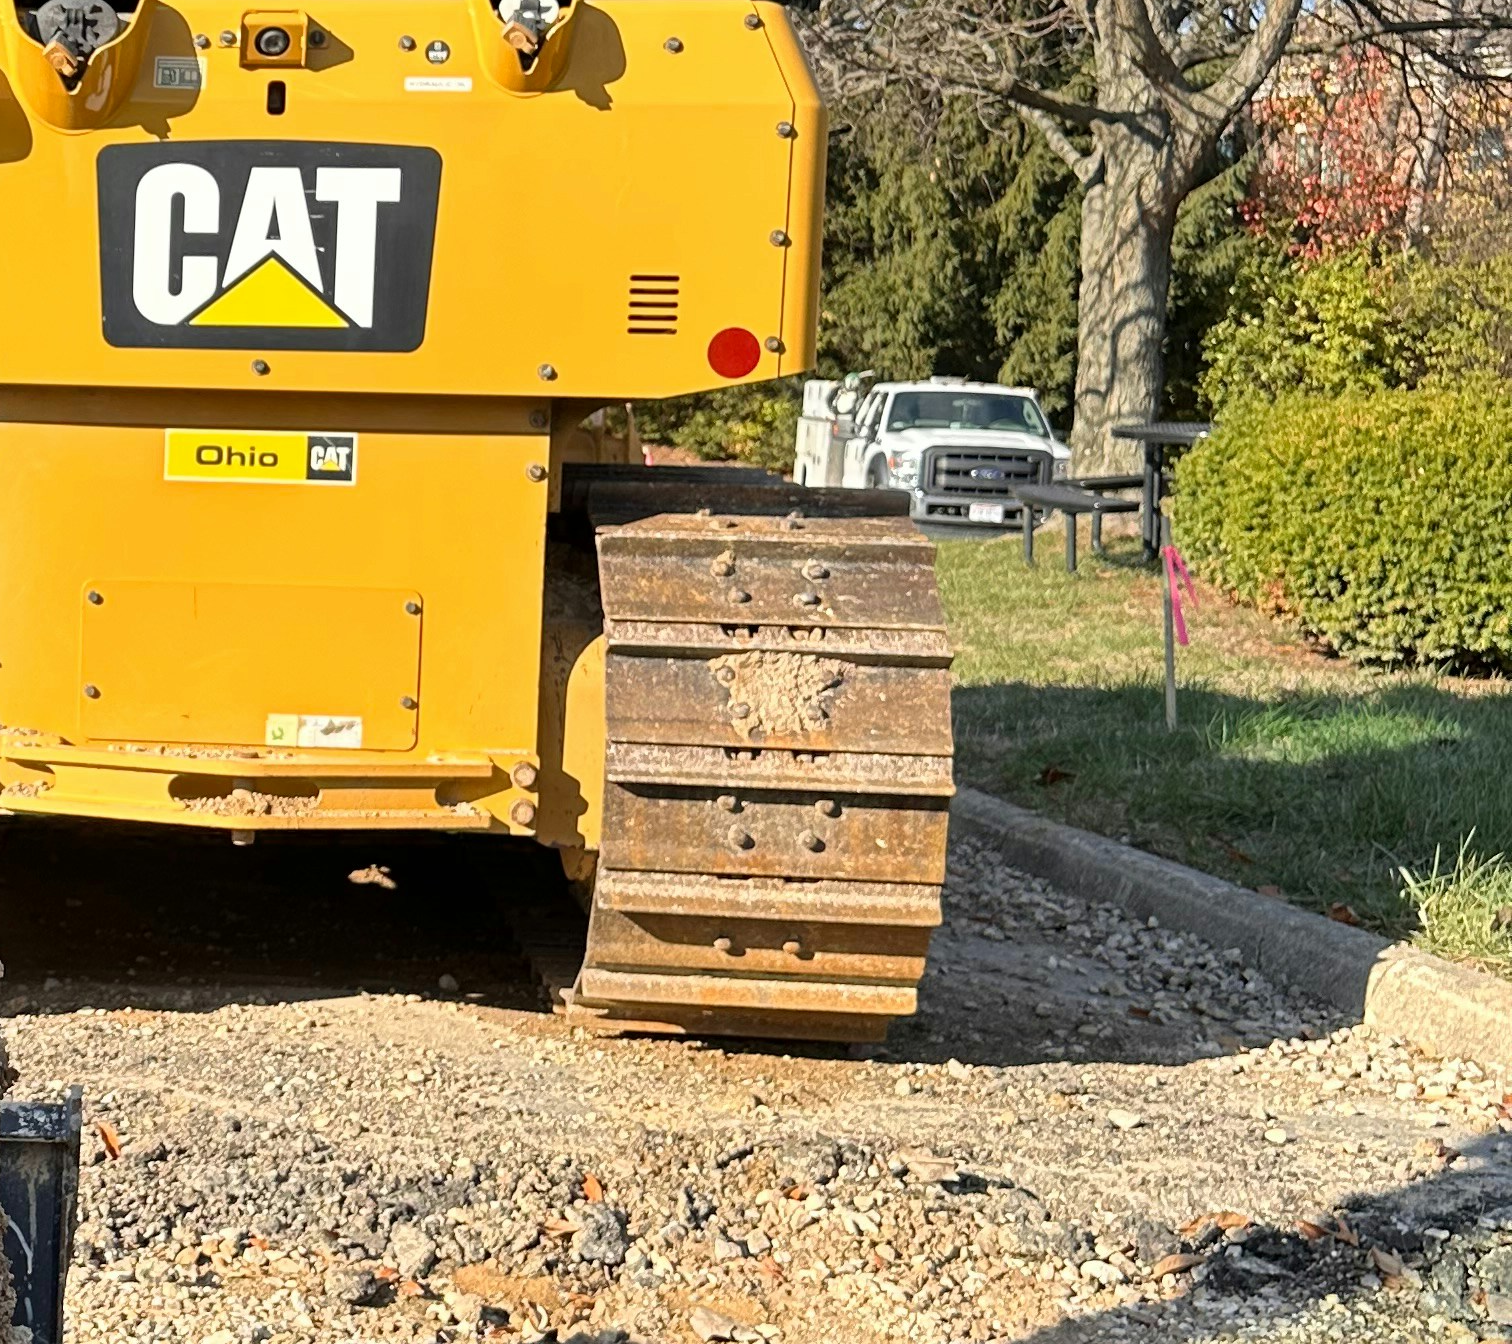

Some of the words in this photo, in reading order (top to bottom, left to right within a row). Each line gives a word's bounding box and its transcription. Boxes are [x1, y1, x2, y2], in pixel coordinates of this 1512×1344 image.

[133, 163, 401, 328] CAT
[195, 444, 279, 468] Ohio
[310, 445, 350, 471] CAT
